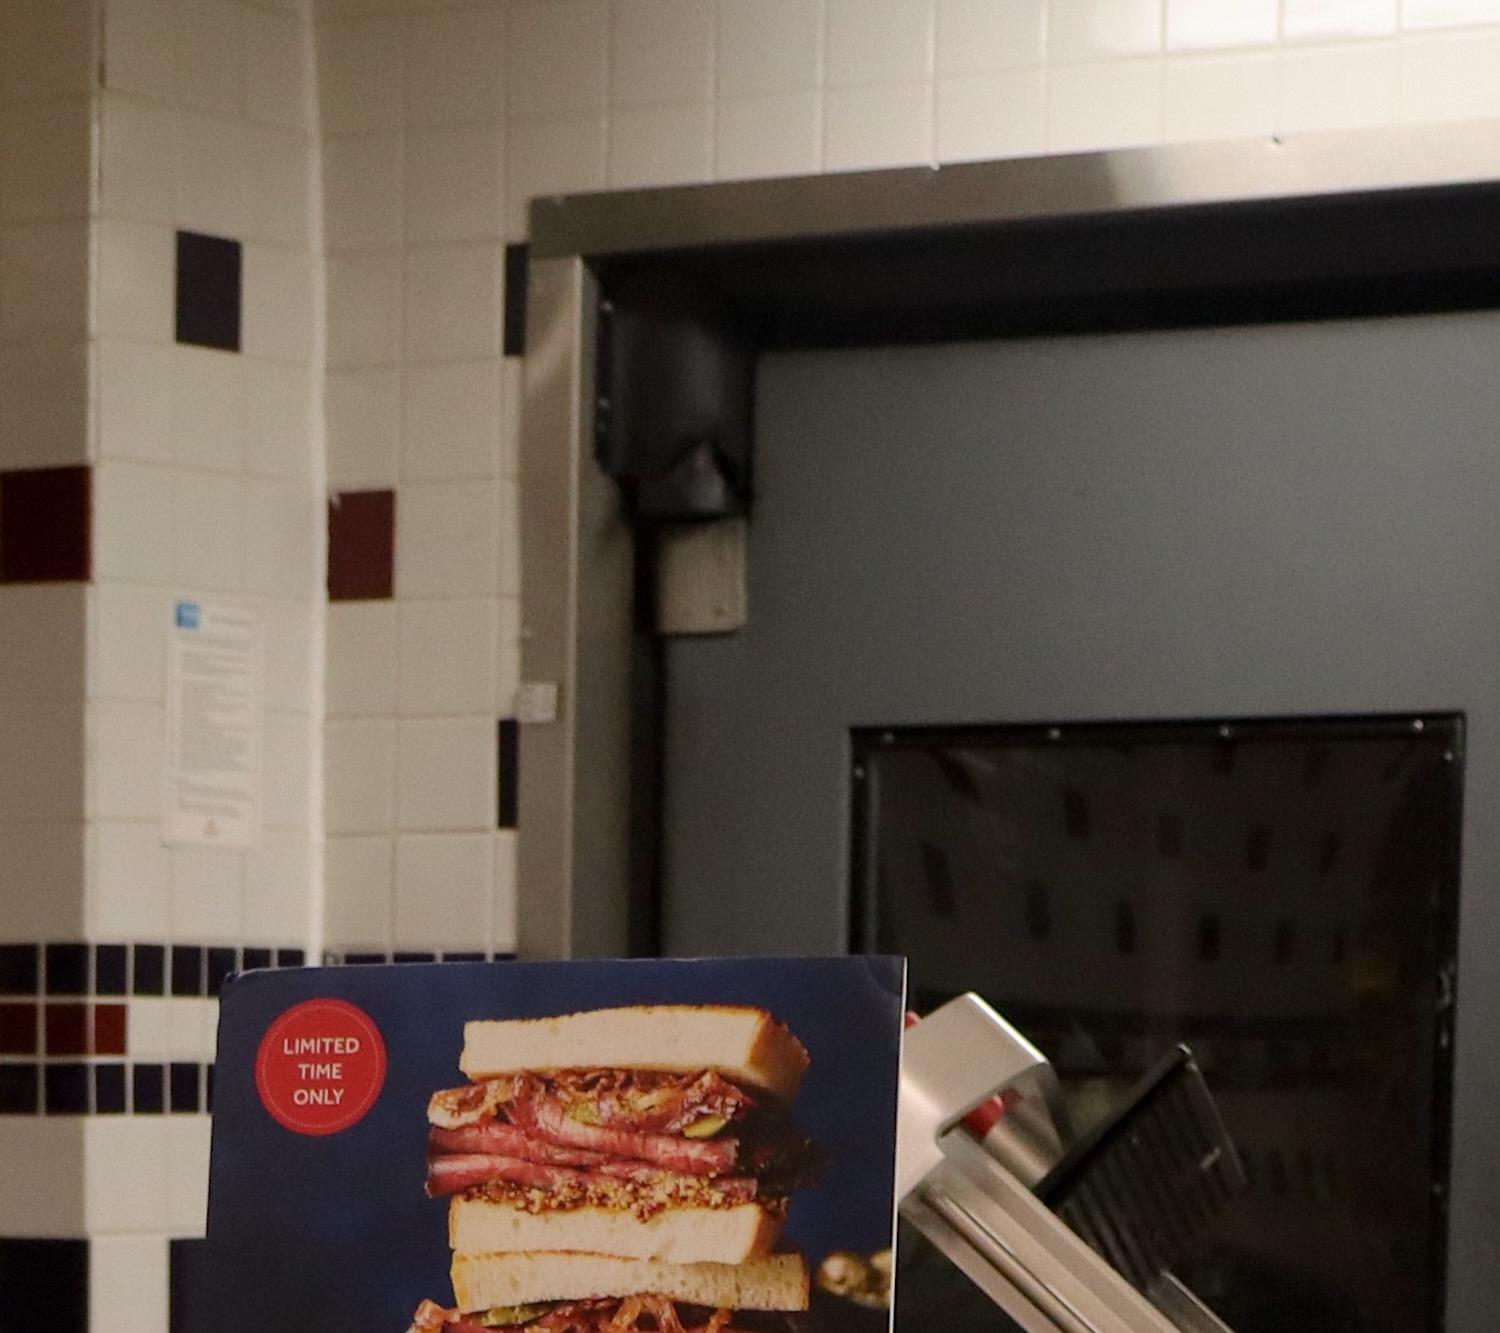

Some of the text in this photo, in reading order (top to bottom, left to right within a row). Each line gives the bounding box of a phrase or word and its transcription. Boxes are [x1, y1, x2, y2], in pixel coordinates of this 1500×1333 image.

[283, 1036, 360, 1056] LIMITED
[297, 1061, 343, 1081] TIME
[292, 1087, 345, 1108] ONLY
